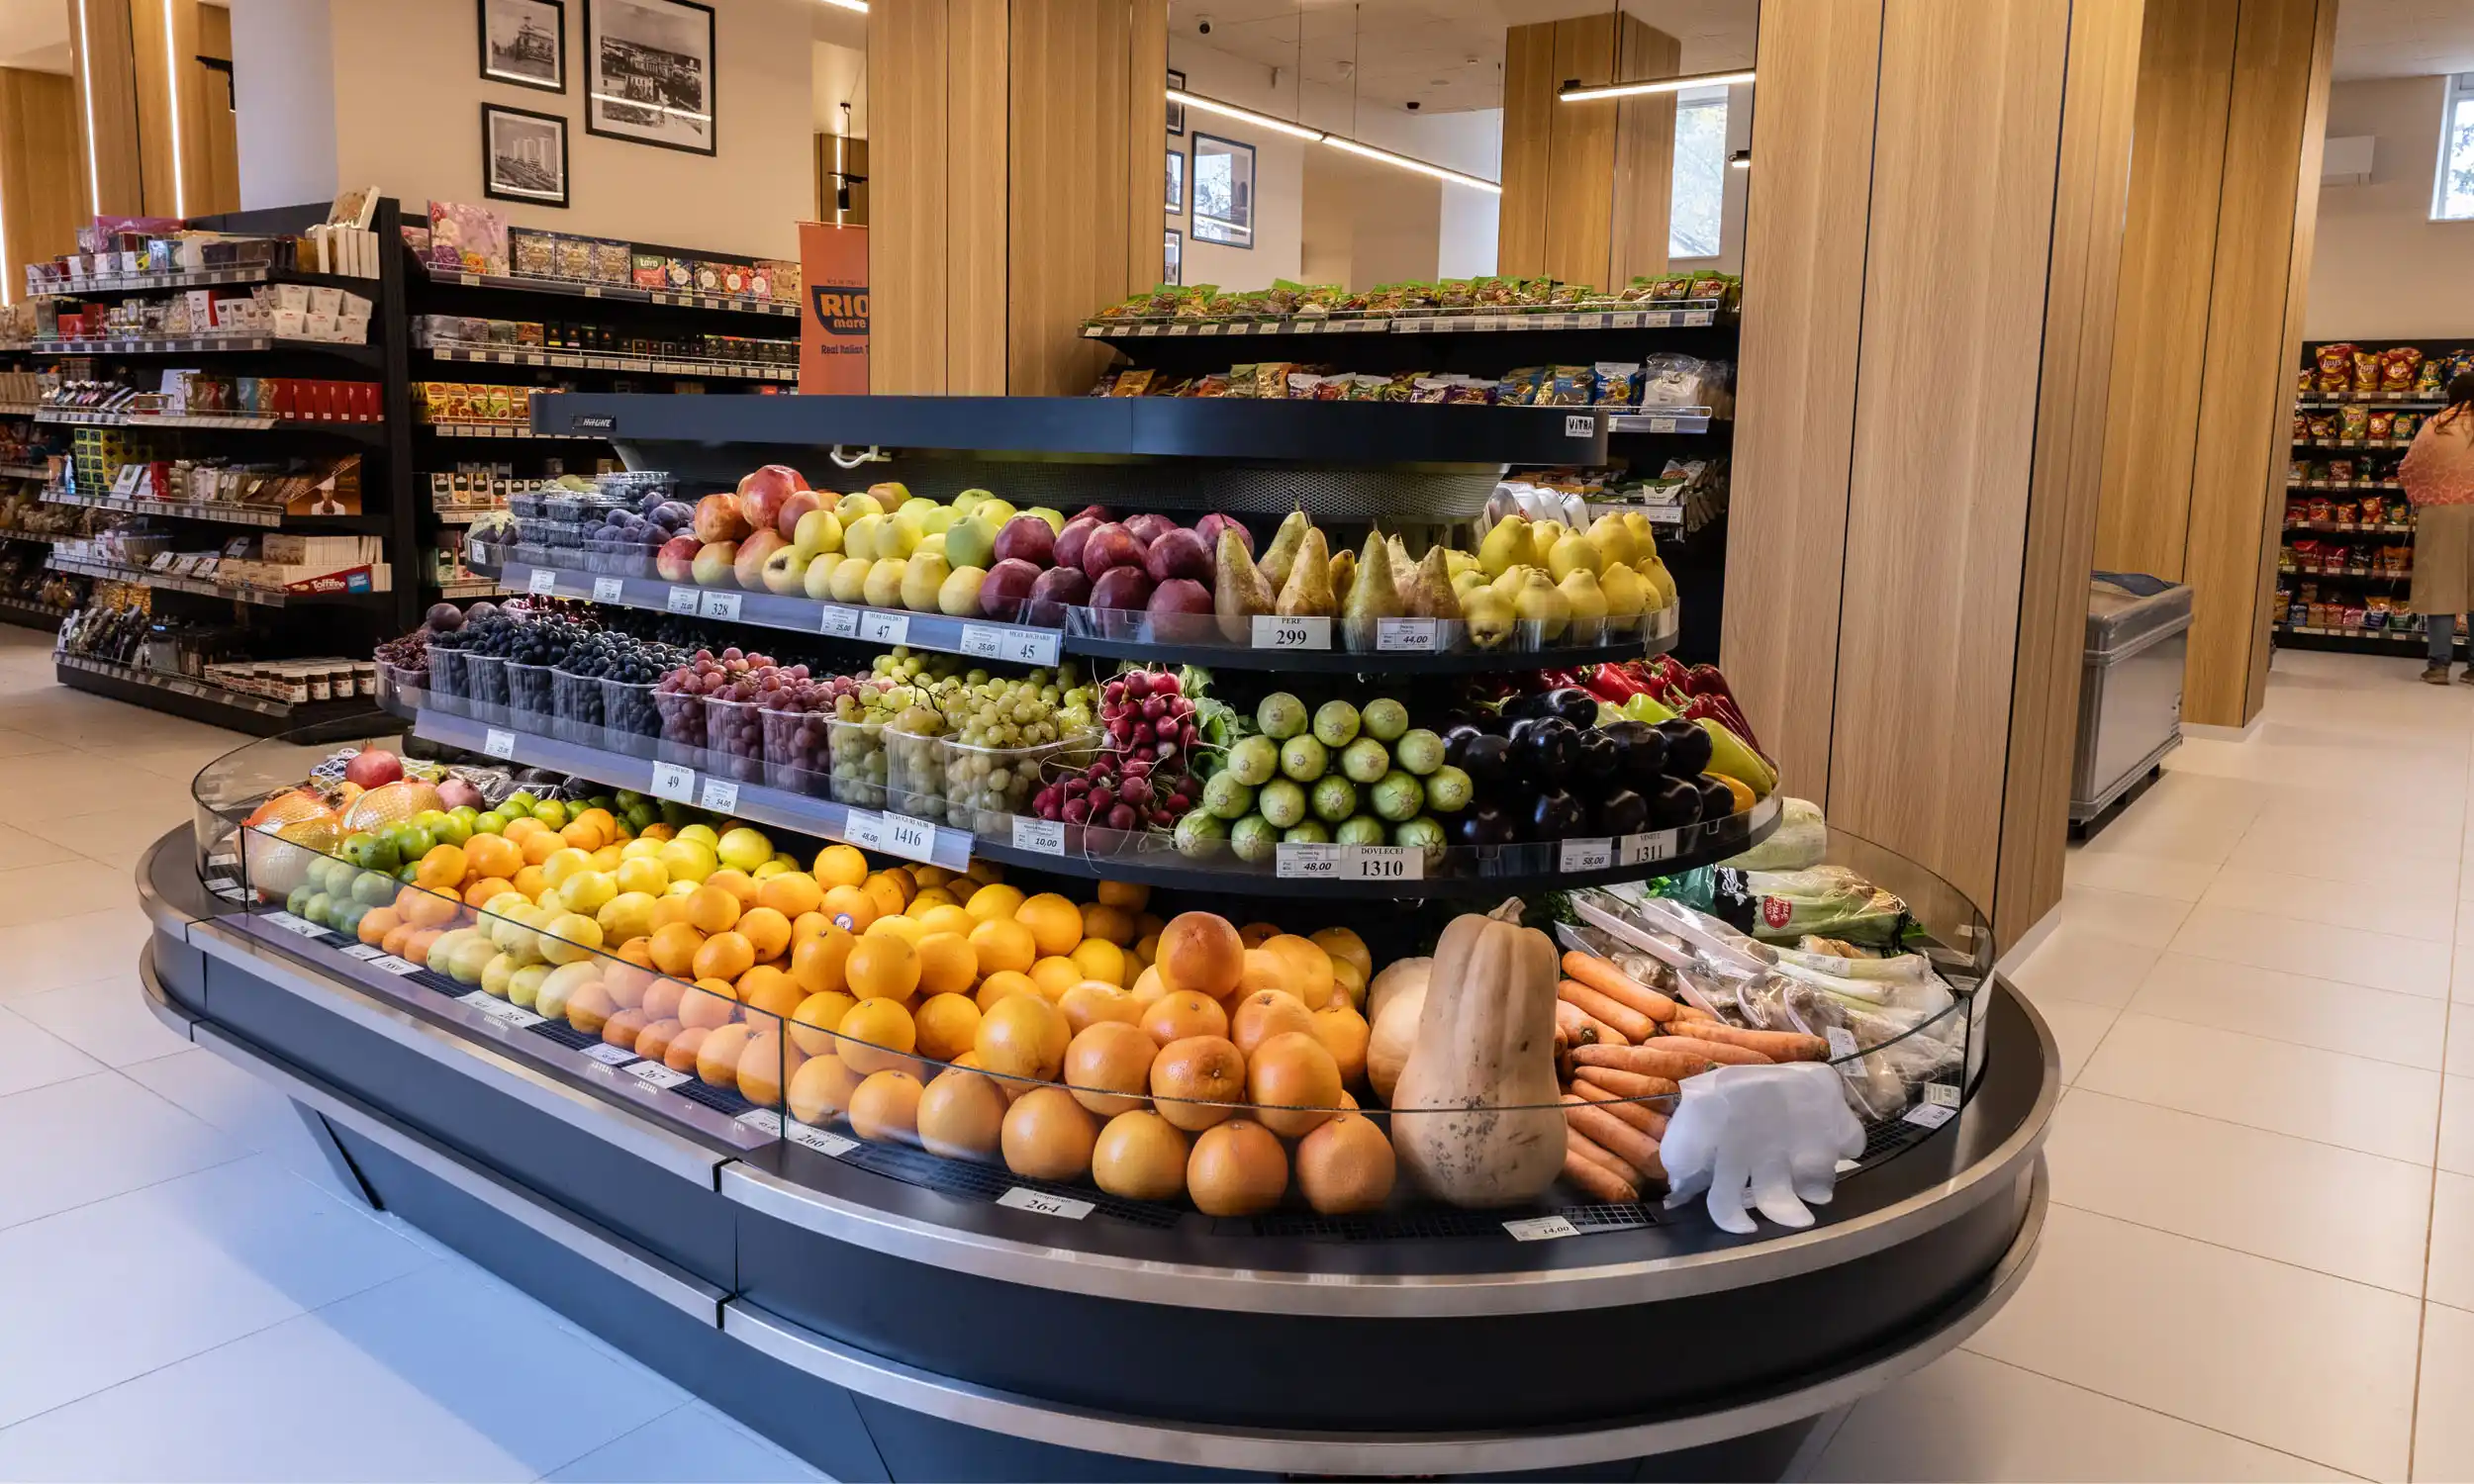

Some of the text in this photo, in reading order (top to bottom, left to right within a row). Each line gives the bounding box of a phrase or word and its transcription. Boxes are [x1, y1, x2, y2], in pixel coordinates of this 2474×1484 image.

[833, 319, 866, 328] mare
[712, 603, 729, 616] 328
[877, 625, 890, 639] 47
[1276, 629, 1307, 645] 299
[1402, 635, 1428, 644] 44,00
[978, 643, 996, 652] 25,00
[1019, 644, 1035, 659] 45
[667, 776, 679, 788] 49
[861, 832, 879, 843] 48,00
[894, 826, 921, 847] 1416
[1034, 837, 1058, 848] 10,00
[1635, 844, 1664, 863] 1311
[1303, 862, 1332, 872] 48,00
[1582, 856, 1604, 867] 58,00
[1361, 860, 1404, 877] 1310
[639, 1068, 665, 1081] 267
[1024, 1199, 1062, 1213] 264
[1543, 1226, 1570, 1235] 14,00
